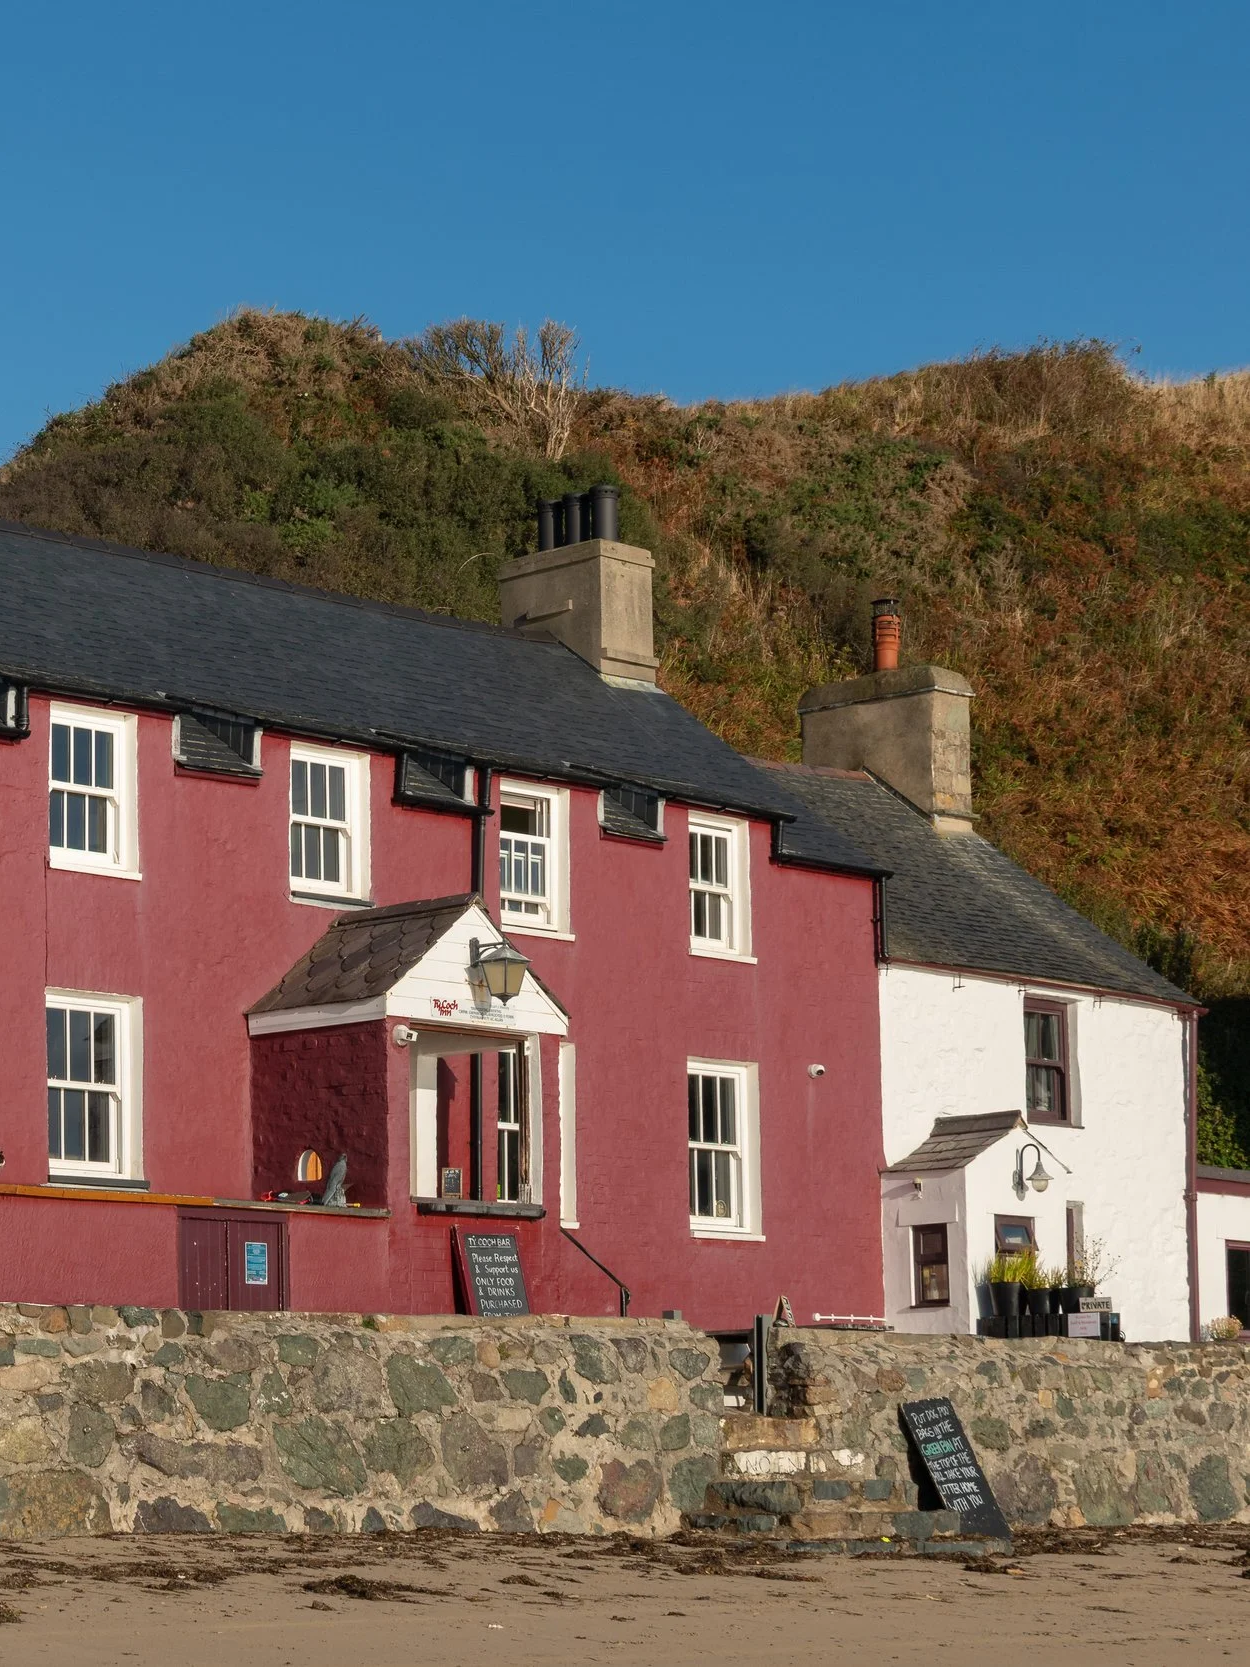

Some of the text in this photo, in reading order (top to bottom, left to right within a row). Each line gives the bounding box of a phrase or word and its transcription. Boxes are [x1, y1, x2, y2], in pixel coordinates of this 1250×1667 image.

[442, 1000, 458, 1010] Coch
[478, 1238, 496, 1246] COCH
[497, 1238, 511, 1246] BAR
[472, 1253, 518, 1265] Please Respect
[475, 1265, 480, 1274] &
[484, 1264, 508, 1276] Support
[476, 1276, 514, 1286] ONLY FOOD
[478, 1287, 516, 1296] & DRINKS
[480, 1299, 523, 1310] PURCHASED
[1081, 1301, 1110, 1310] PRIVATE
[910, 1412, 926, 1426] PUT
[926, 1409, 938, 1422] DOG
[939, 1420, 954, 1434] THE
[921, 1442, 942, 1456] GREEN
[940, 1439, 956, 1453] BIN
[940, 1458, 950, 1468] TOP
[958, 1452, 972, 1464] THE
[946, 1468, 962, 1480] TAKE
[959, 1466, 980, 1478] YOUR
[960, 1482, 980, 1494] HOME
